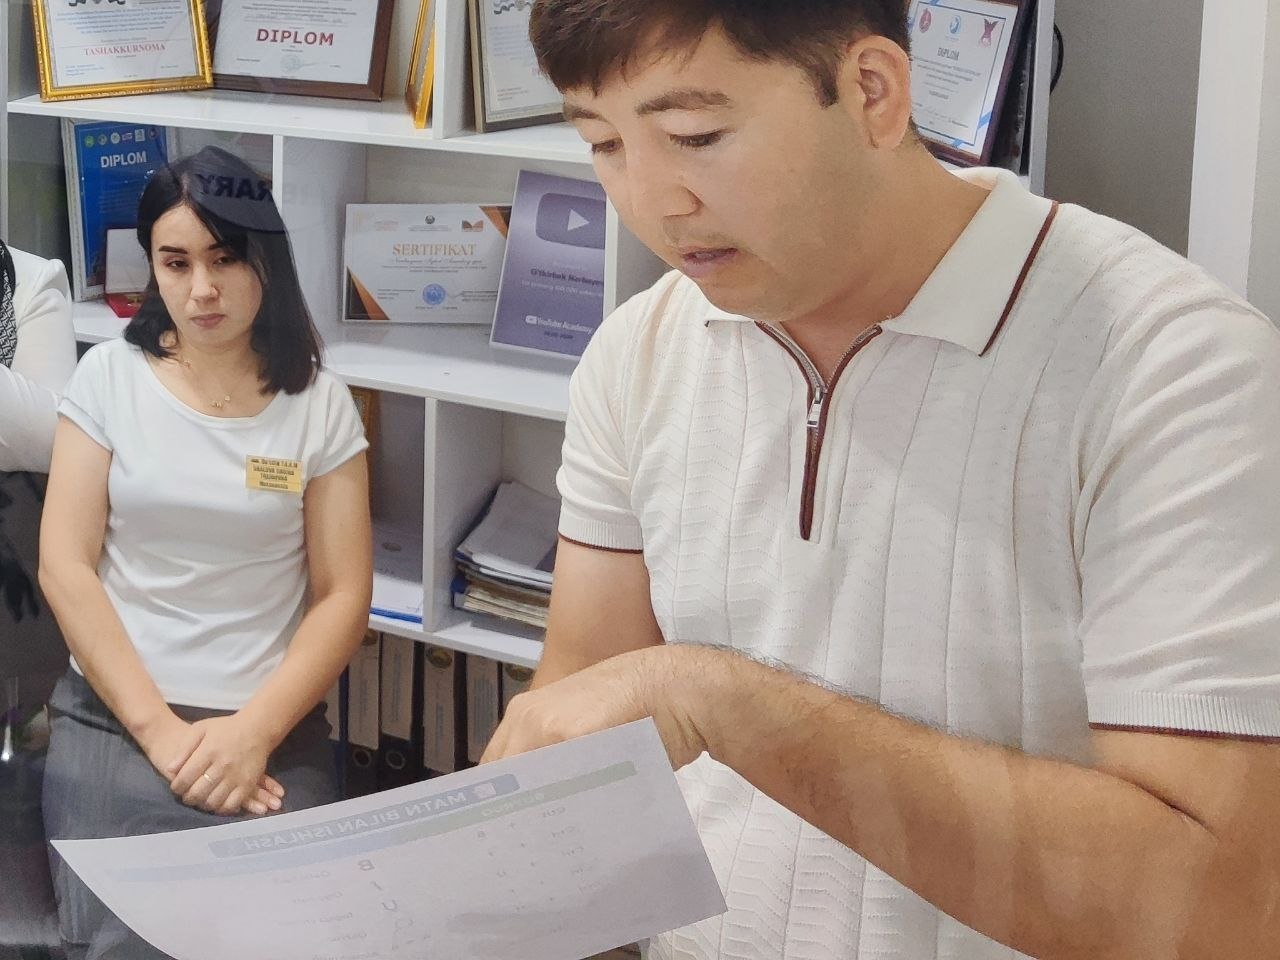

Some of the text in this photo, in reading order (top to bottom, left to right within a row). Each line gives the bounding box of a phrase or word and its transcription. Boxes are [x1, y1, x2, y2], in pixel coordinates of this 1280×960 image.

[256, 27, 334, 46] DIPLOM
[100, 150, 147, 168] DIPLOM
[392, 243, 477, 256] SERTIFIKAT
